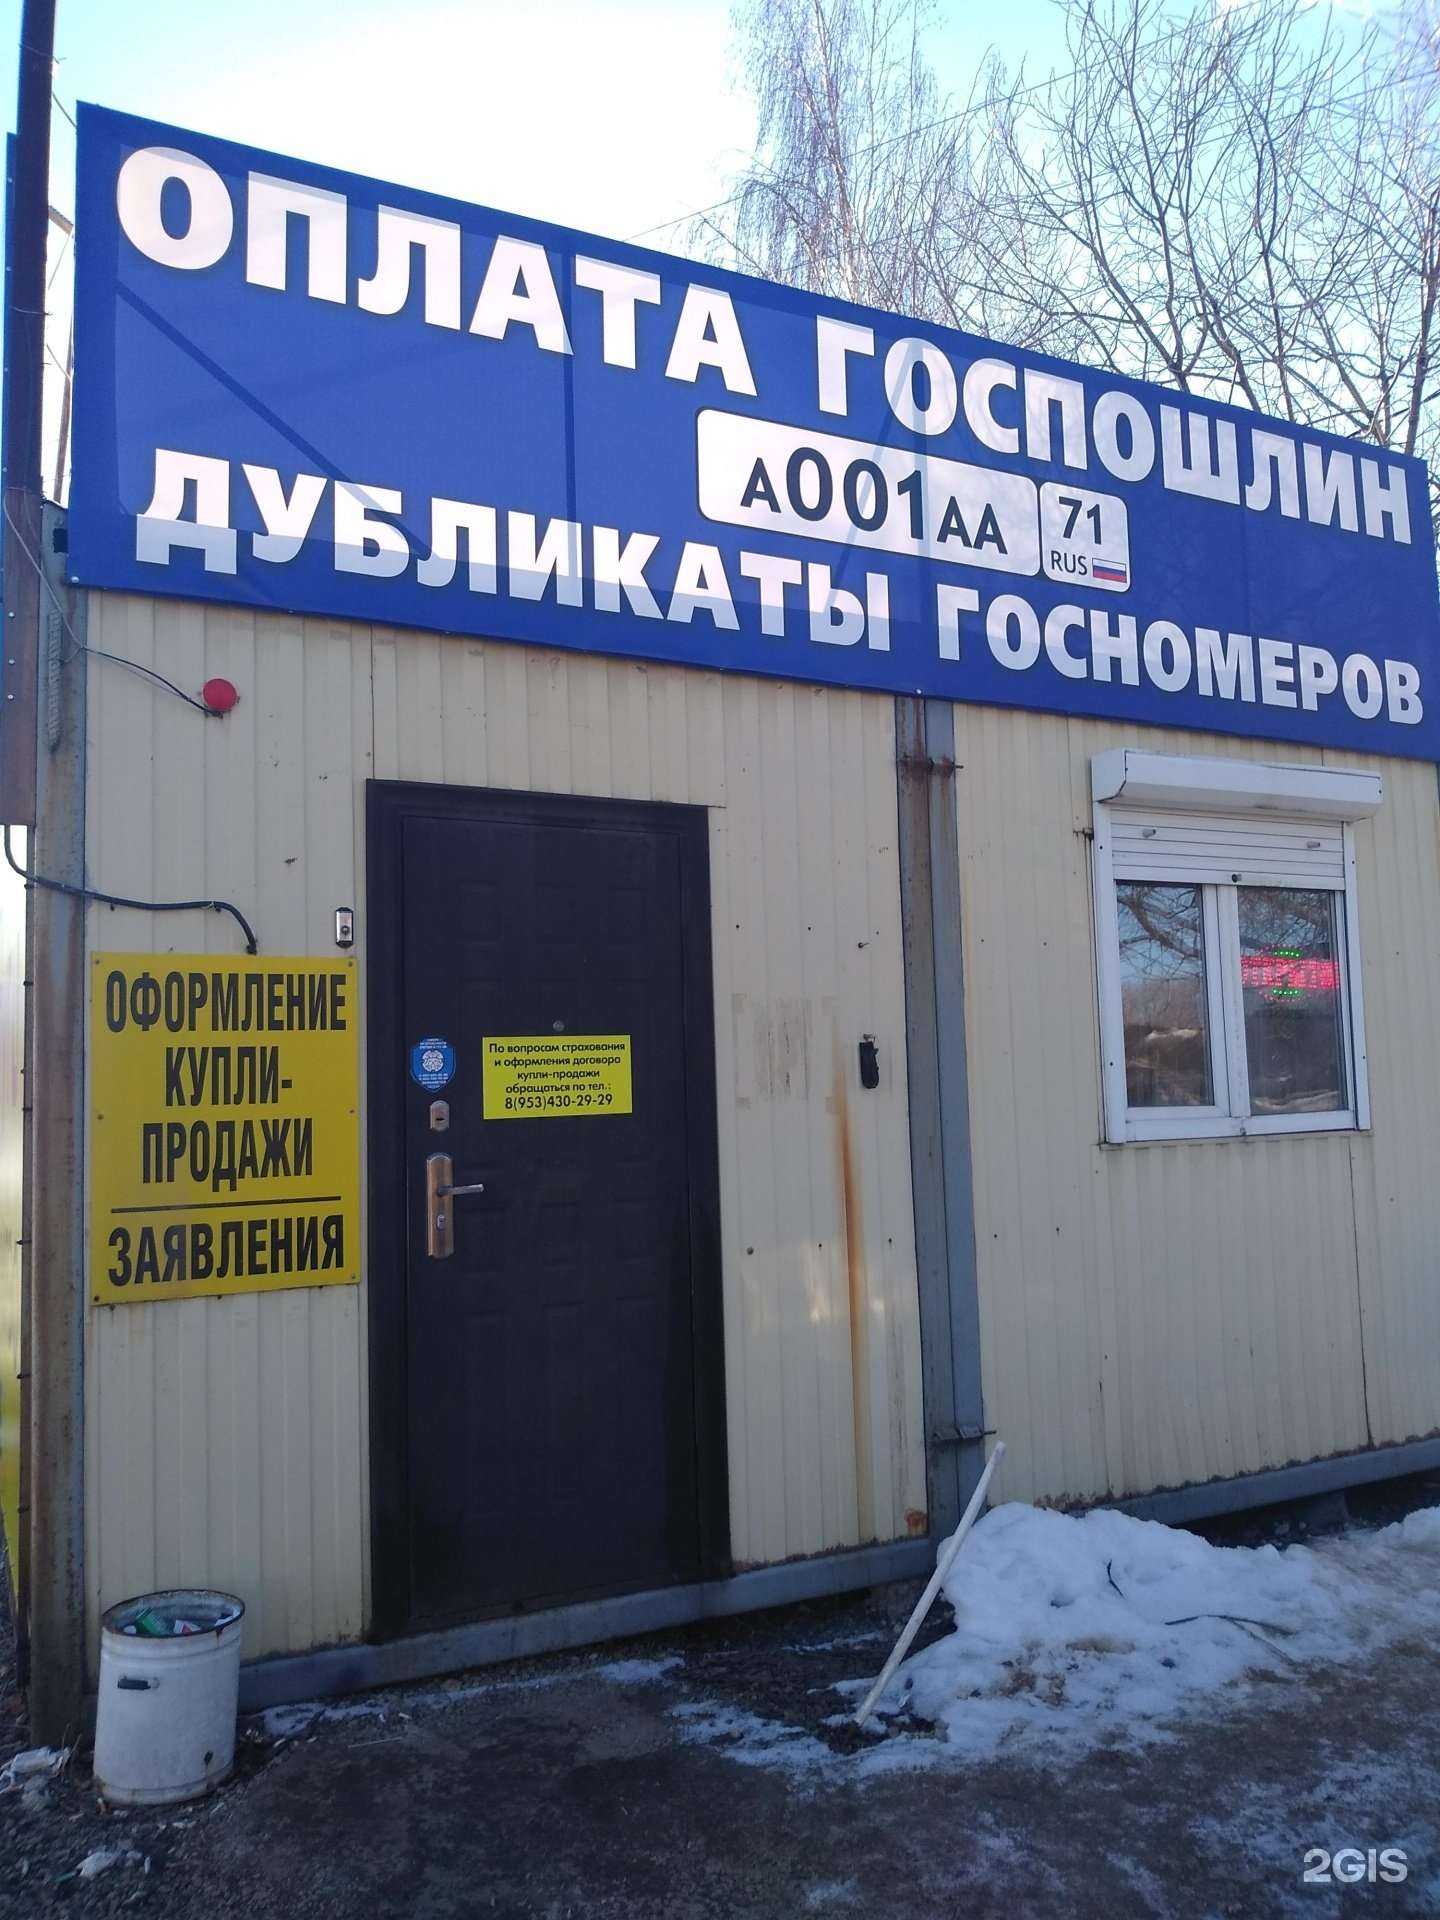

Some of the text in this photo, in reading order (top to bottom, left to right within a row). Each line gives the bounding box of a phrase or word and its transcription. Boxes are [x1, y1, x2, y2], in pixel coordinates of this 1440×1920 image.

[116, 146, 1412, 545] ОПЛАТА ГОСПОШЛИН
[1058, 496, 1103, 546] 71
[135, 448, 1424, 725] ДУБЛИКАТЫ ГОСНОМЕРОВ
[1050, 550, 1089, 577] RUS
[106, 970, 347, 1033] ОФОРМЛЕНИЕ
[489, 1042, 626, 1055] По вопросам страхования
[494, 1055, 621, 1071] и оформления договора
[165, 1046, 293, 1107] КУПЛИ-
[505, 1082, 571, 1094] обращаться
[572, 1083, 586, 1091] по
[517, 1070, 600, 1082] купли-продажи
[504, 1093, 613, 1112] 8(953)430-29-29
[142, 1118, 313, 1192] ПРОДАЖИ
[108, 1214, 344, 1287] ЗАЯВЛЕНИЯ
